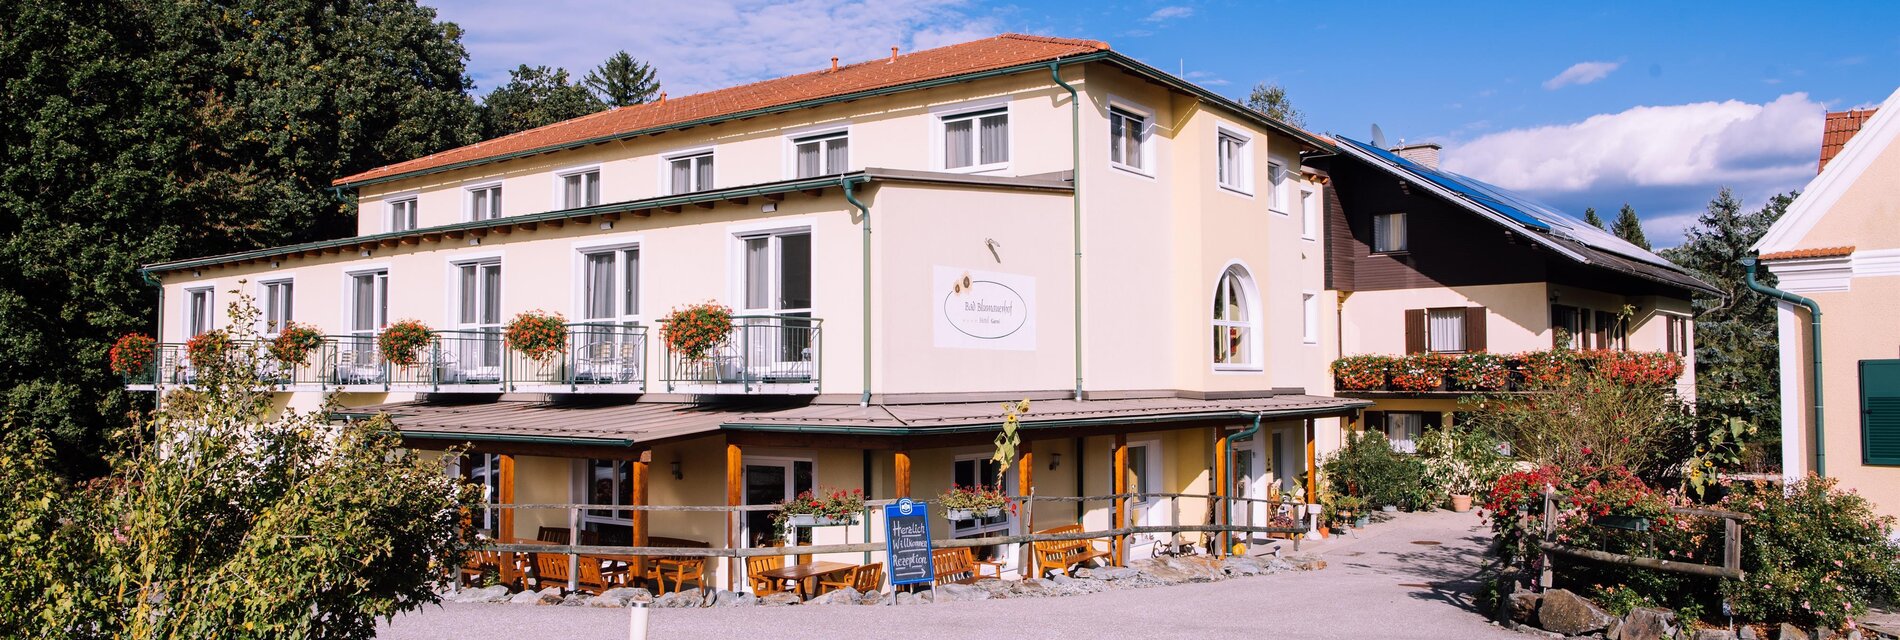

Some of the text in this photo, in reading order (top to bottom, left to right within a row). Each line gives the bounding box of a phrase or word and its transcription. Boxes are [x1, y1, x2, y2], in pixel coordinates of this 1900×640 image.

[964, 300, 976, 311] Bad
[892, 520, 925, 536] Herzlich
[892, 553, 927, 567] Rezeption
